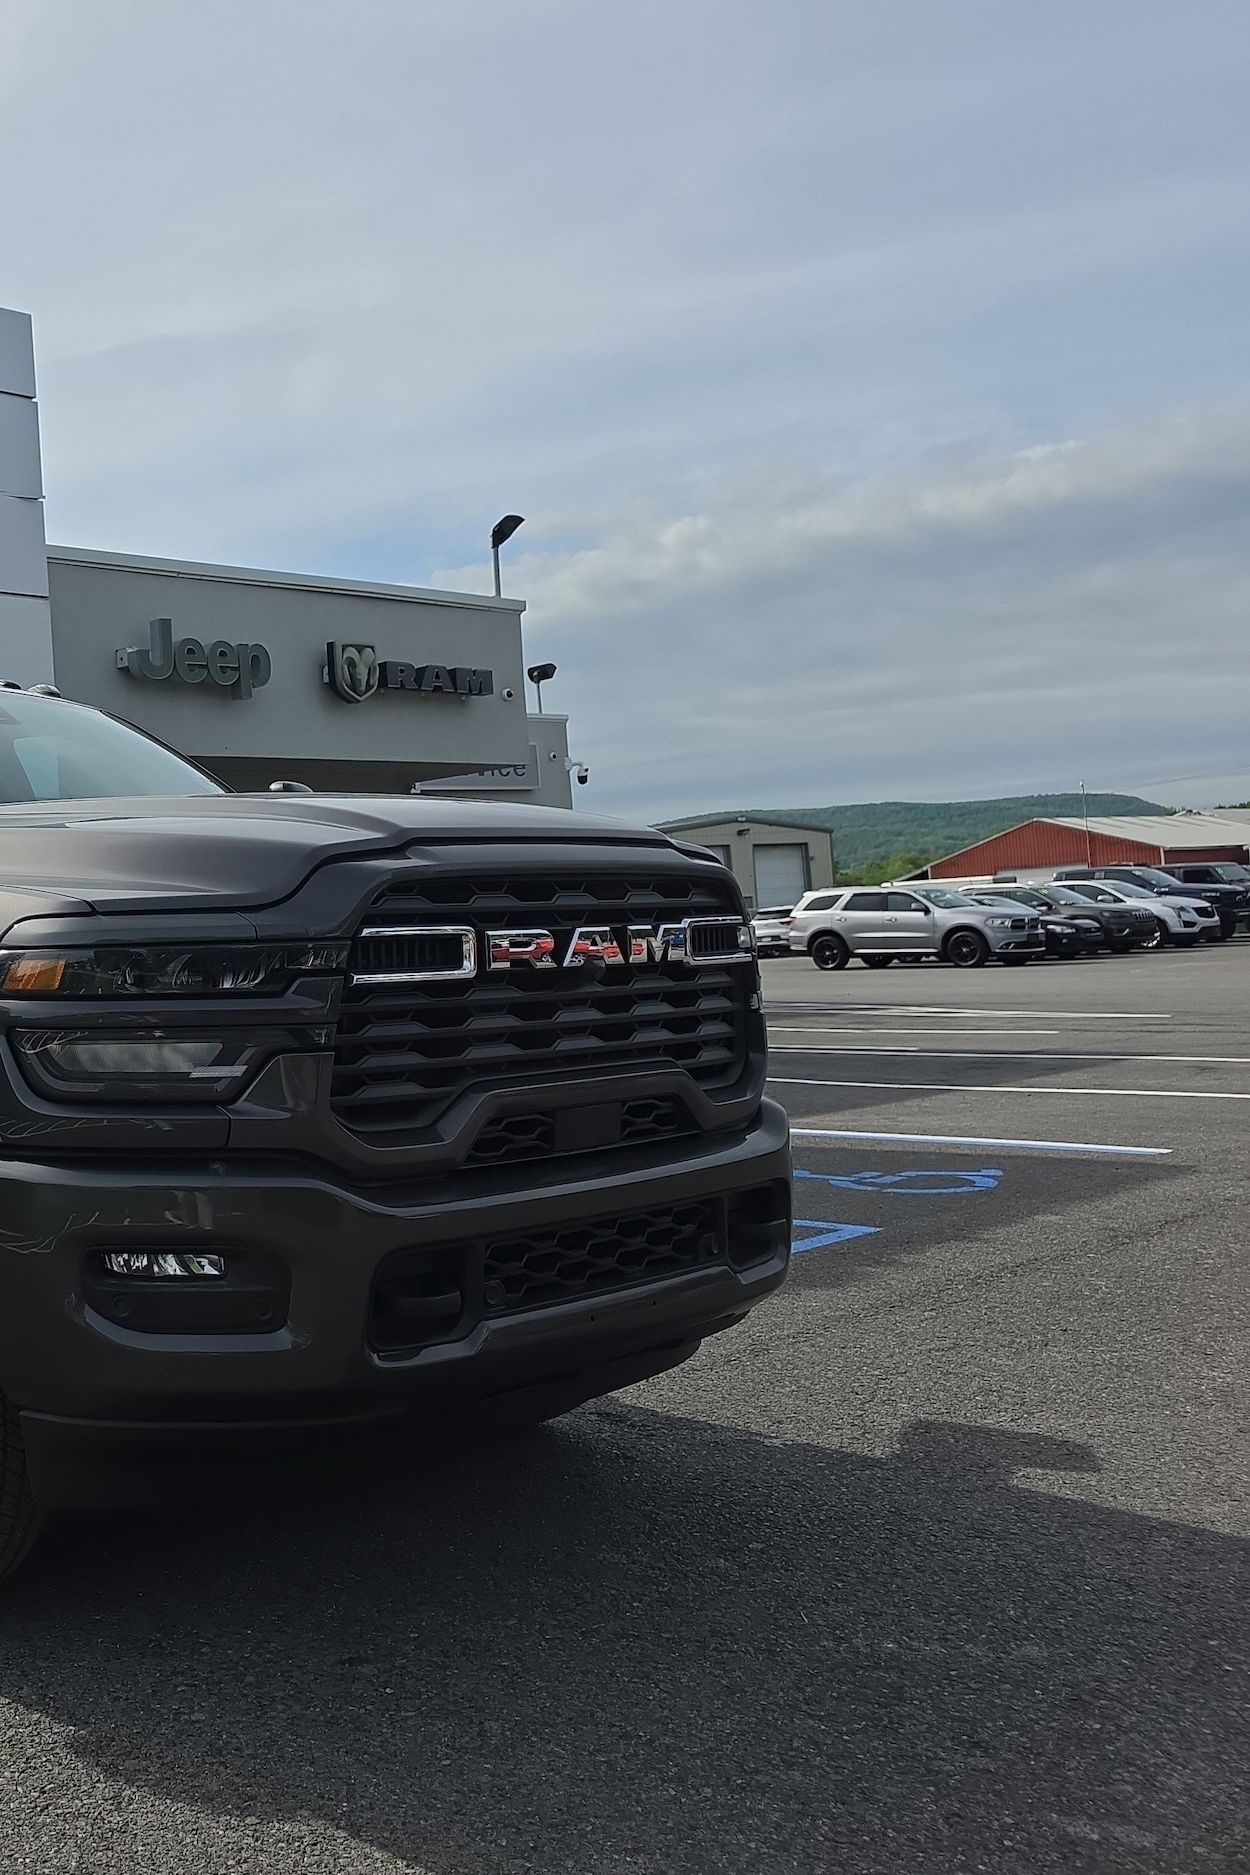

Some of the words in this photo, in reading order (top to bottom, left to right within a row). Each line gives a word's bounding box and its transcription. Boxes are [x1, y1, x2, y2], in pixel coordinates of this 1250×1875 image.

[130, 618, 272, 699] Jeep
[378, 660, 494, 696] RAM
[486, 924, 688, 971] RAM
